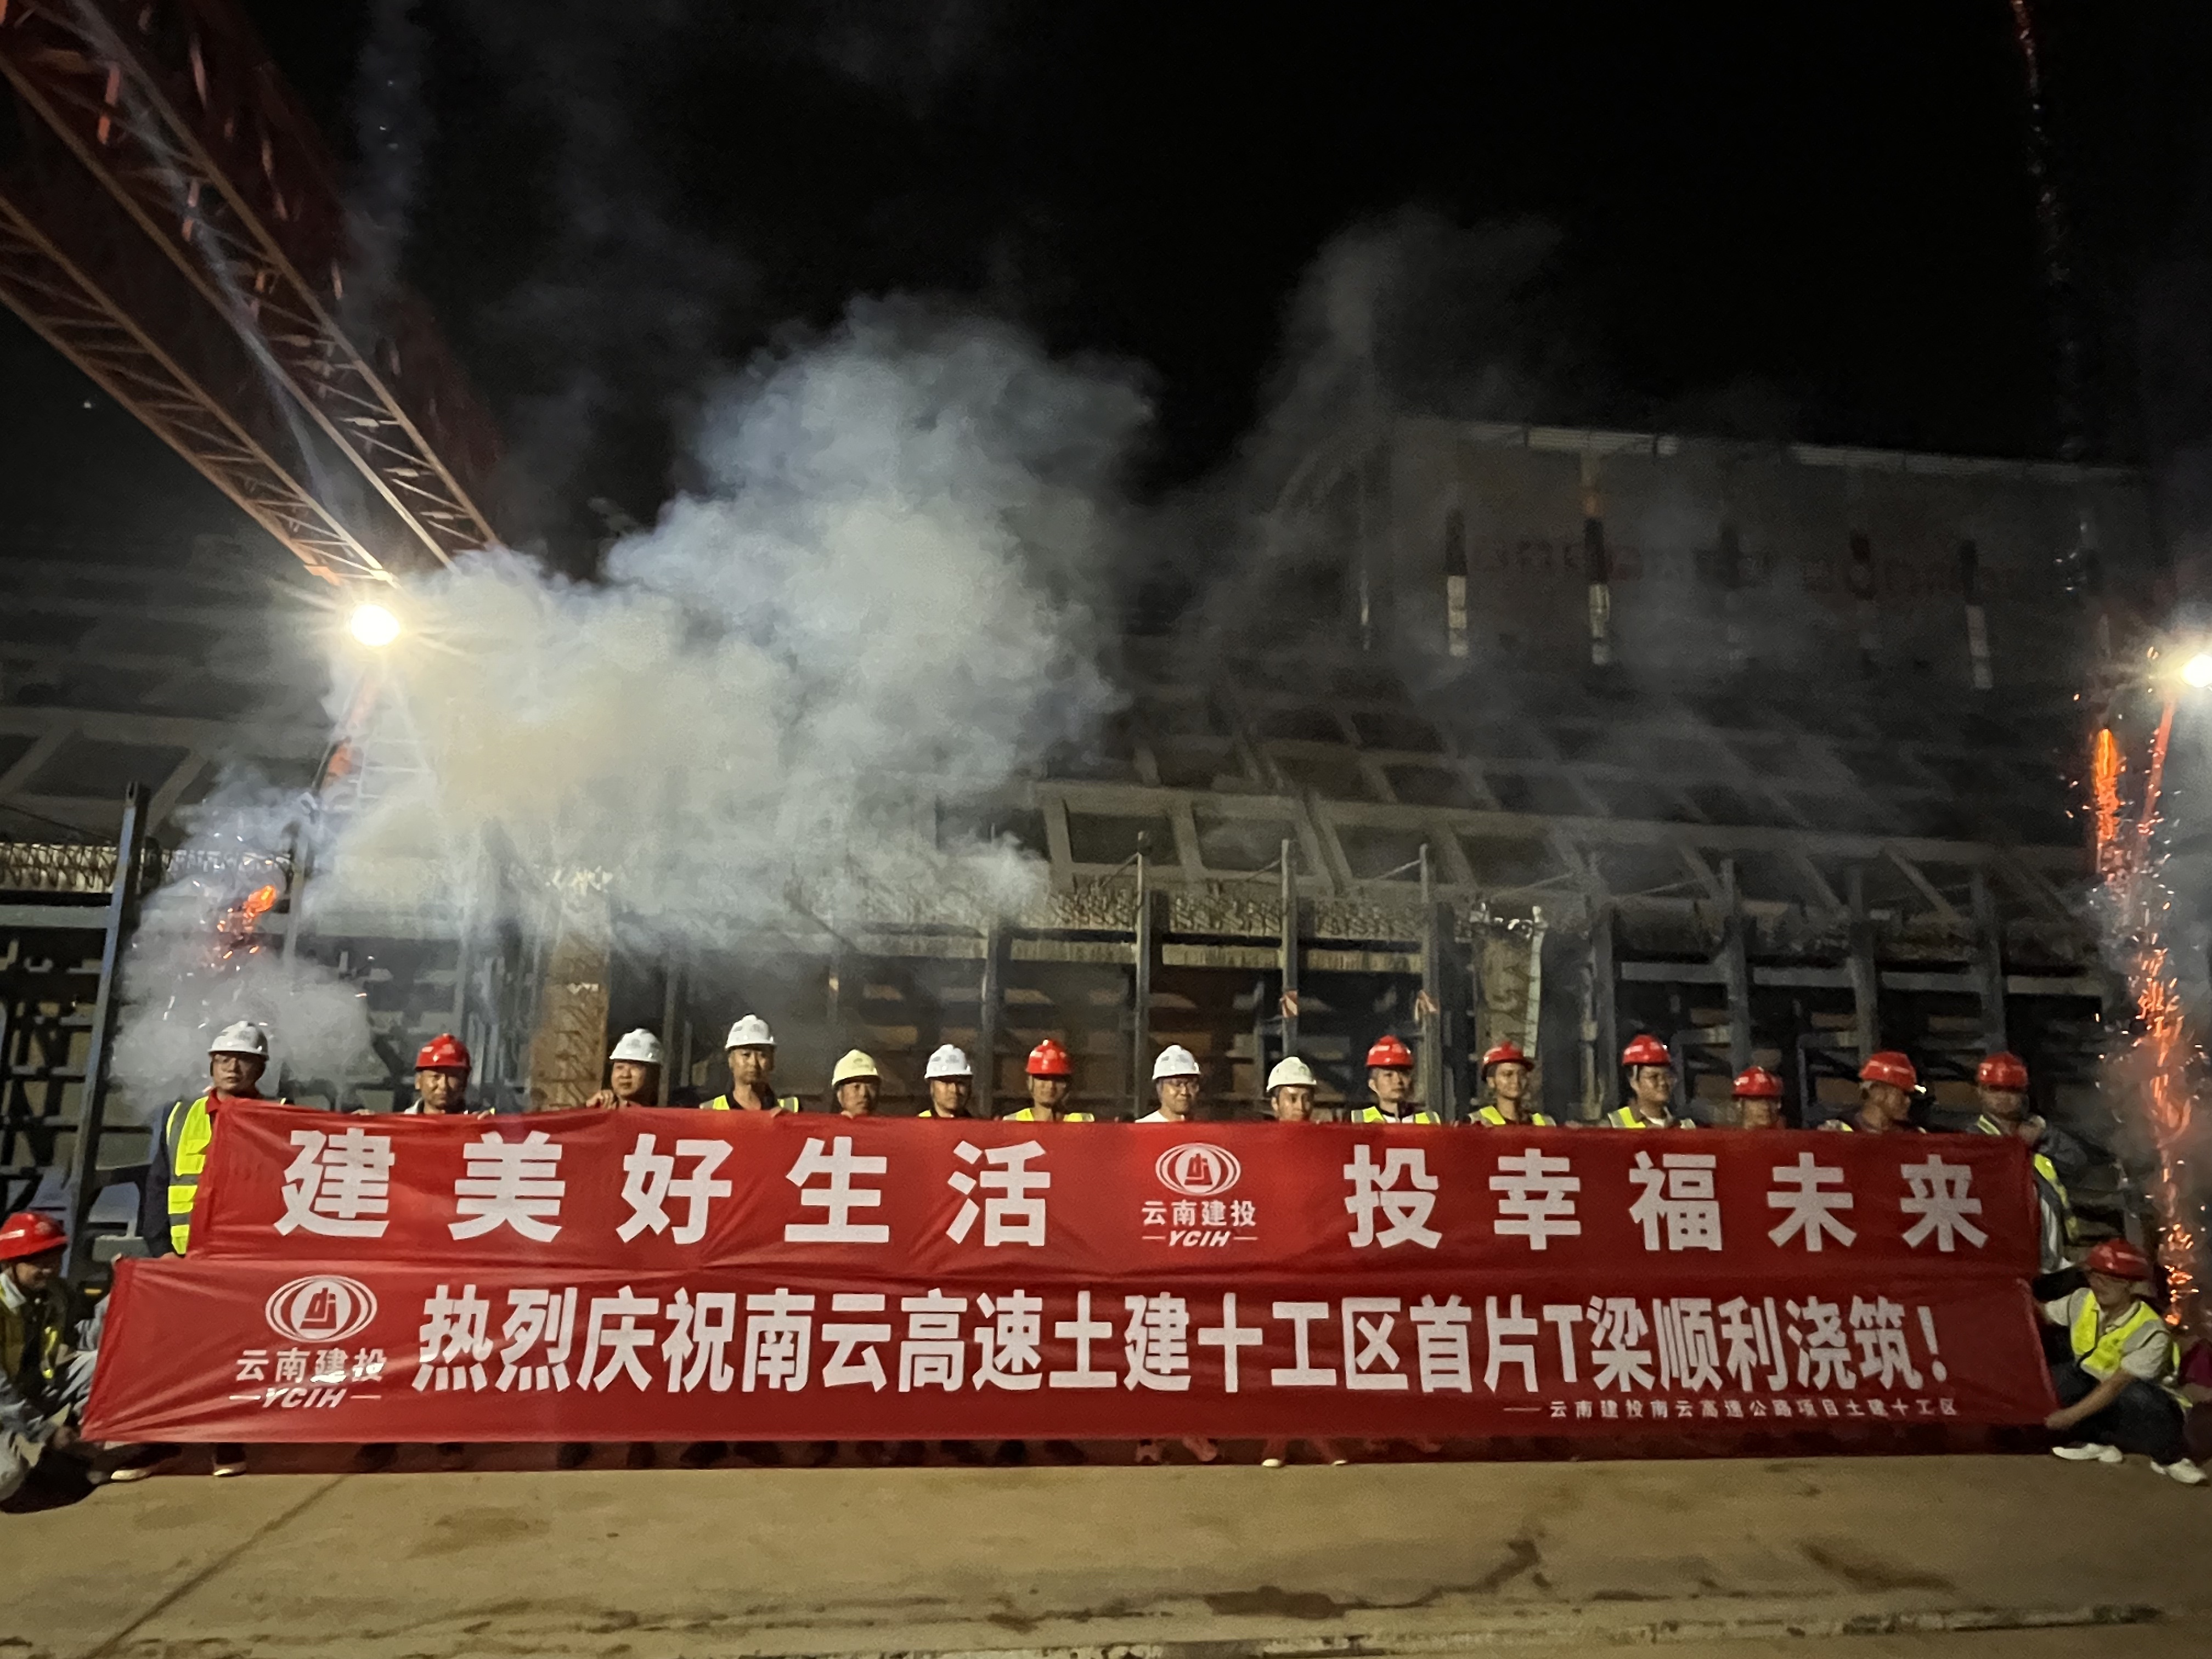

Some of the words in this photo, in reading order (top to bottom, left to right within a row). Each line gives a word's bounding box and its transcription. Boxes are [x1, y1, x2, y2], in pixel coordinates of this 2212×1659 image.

[274, 1128, 1051, 1246] 建美好生活
[1344, 1144, 1989, 1252] 投幸福未来
[1142, 1199, 1256, 1226] 云南建投
[1169, 1231, 1231, 1247] YCIH
[236, 1347, 386, 1383] 云南建投
[262, 1388, 347, 1408] YCIH
